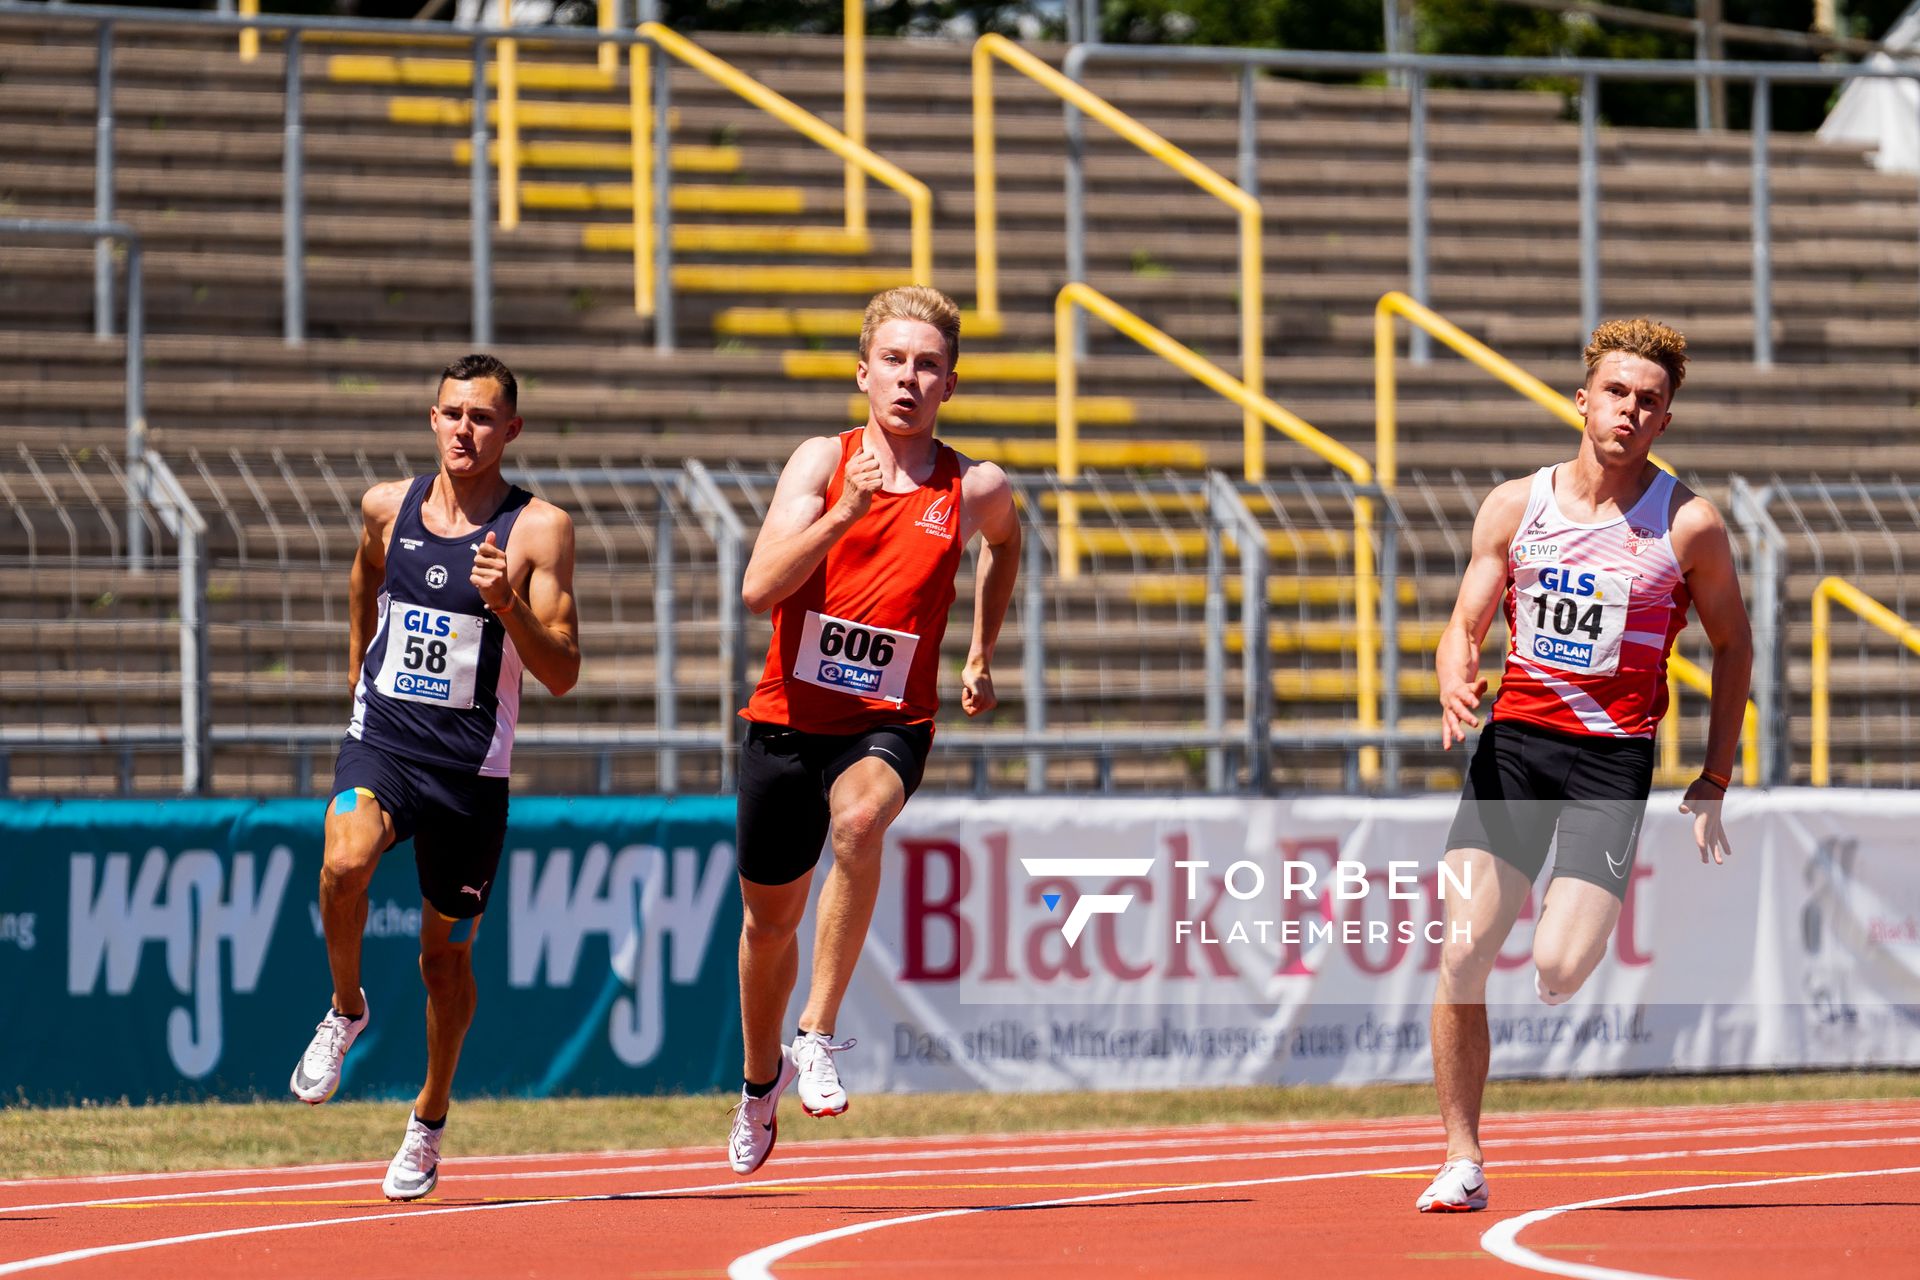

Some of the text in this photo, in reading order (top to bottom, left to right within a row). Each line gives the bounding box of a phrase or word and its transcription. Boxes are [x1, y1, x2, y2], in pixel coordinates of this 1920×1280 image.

[1530, 544, 1558, 555] EWP
[1533, 593, 1605, 641] 104
[403, 635, 447, 674] 58
[820, 621, 897, 667] 606
[1554, 642, 1590, 660] PLAN
[416, 678, 448, 694] PLAN
[843, 668, 880, 685] PLAN
[897, 831, 1653, 983] Black Foret
[894, 1022, 951, 1066] Das
[960, 1019, 1040, 1060] stille
[1291, 1021, 1346, 1059] aus
[1355, 1011, 1425, 1050] dem
[1490, 1005, 1652, 1046] warzwald.
